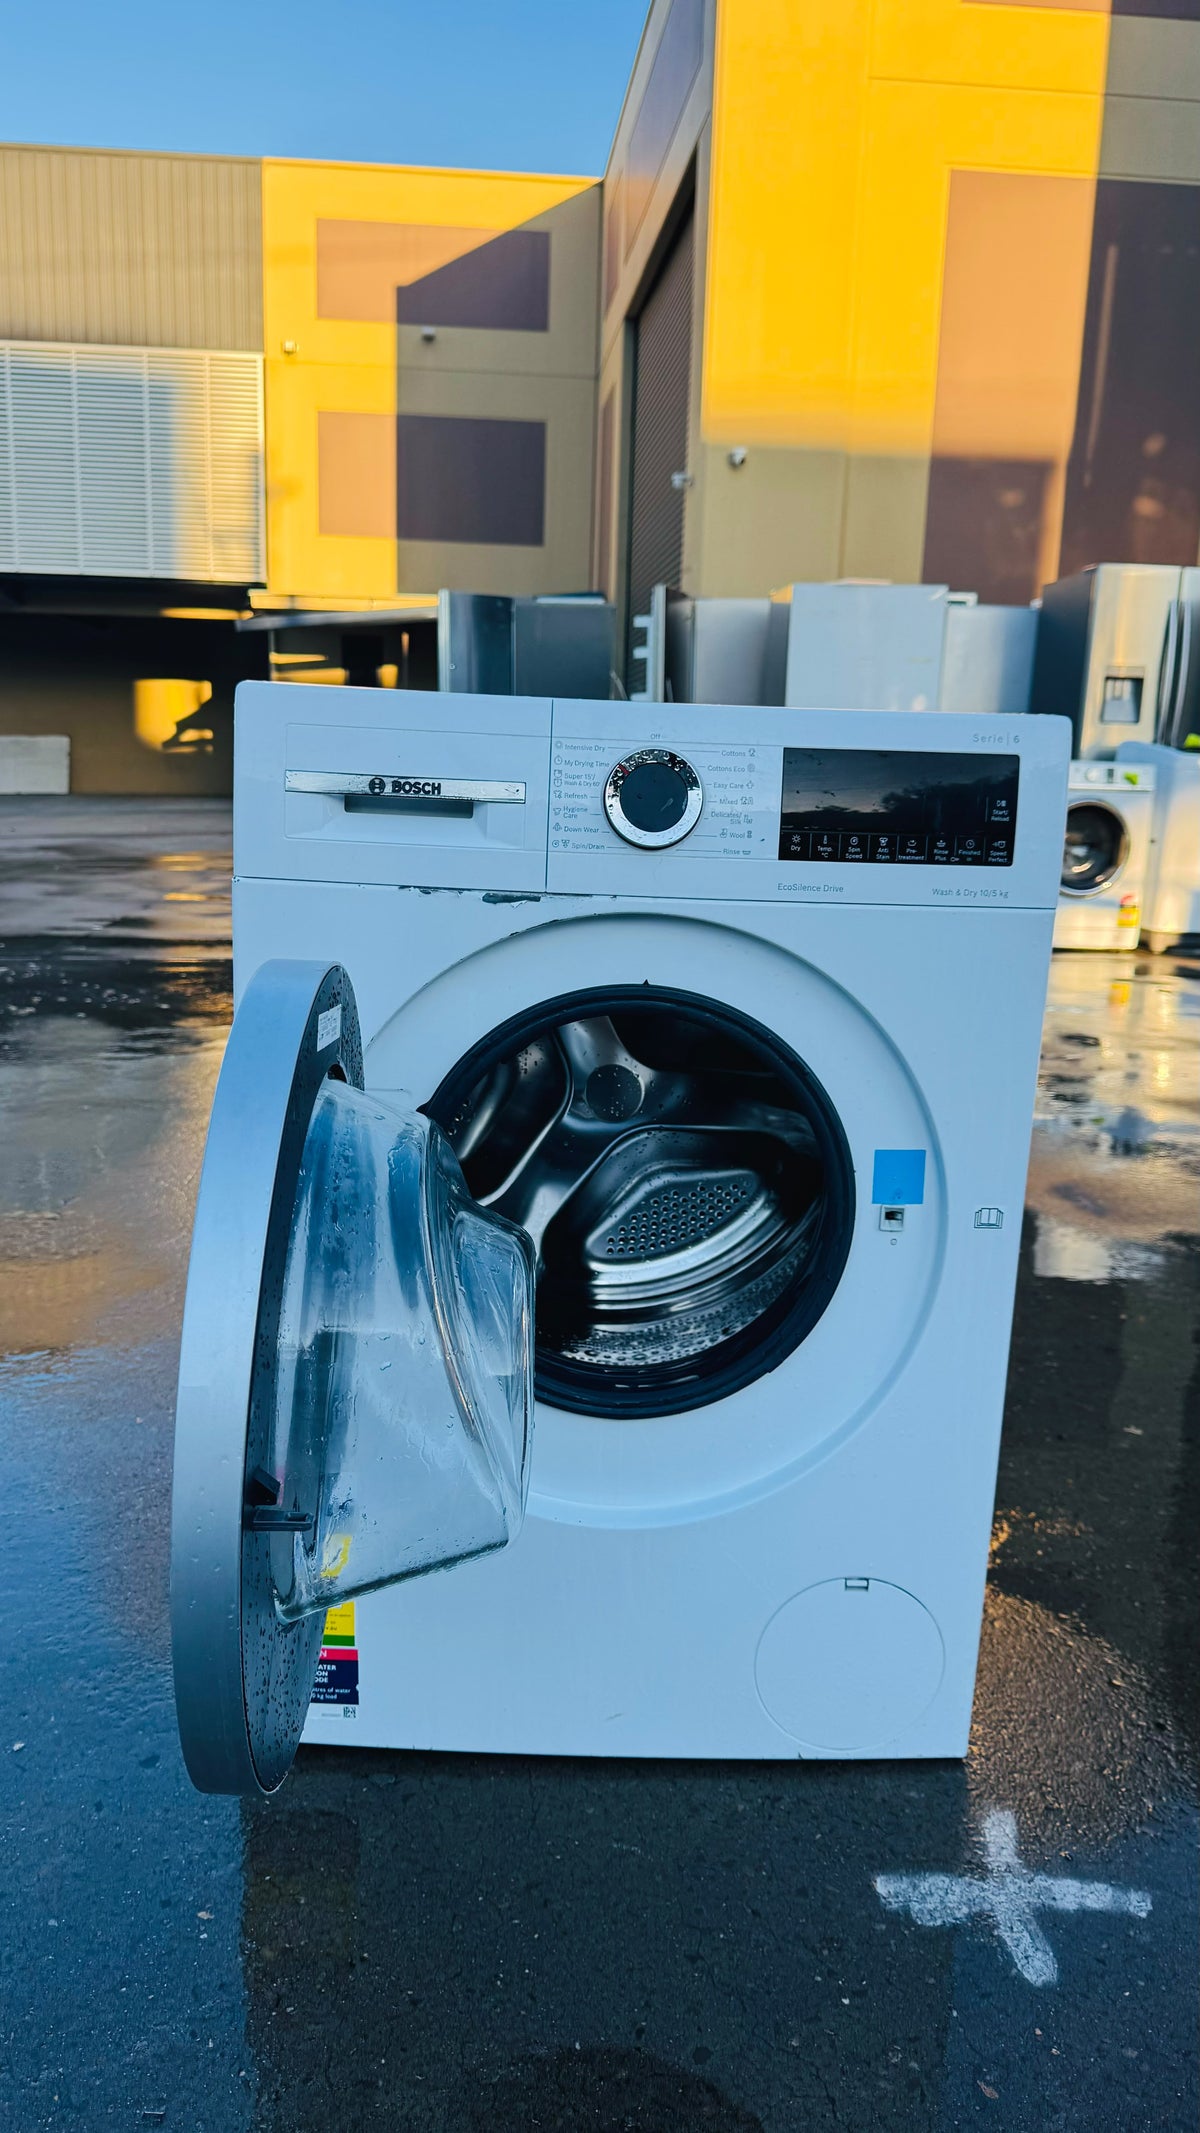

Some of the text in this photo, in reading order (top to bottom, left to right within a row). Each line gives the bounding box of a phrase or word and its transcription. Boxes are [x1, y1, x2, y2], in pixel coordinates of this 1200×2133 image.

[972, 734, 1020, 744] Serie 6
[574, 760, 594, 768] Drying
[708, 764, 732, 772] Cottons
[391, 780, 441, 795] BOSCH
[713, 782, 728, 790] Easy
[563, 805, 588, 813] Hygiene
[777, 883, 844, 892] EcoSilence Drive
[932, 888, 1009, 898] Wash & Dry 10/5 kg
[320, 1650, 328, 1658] N
